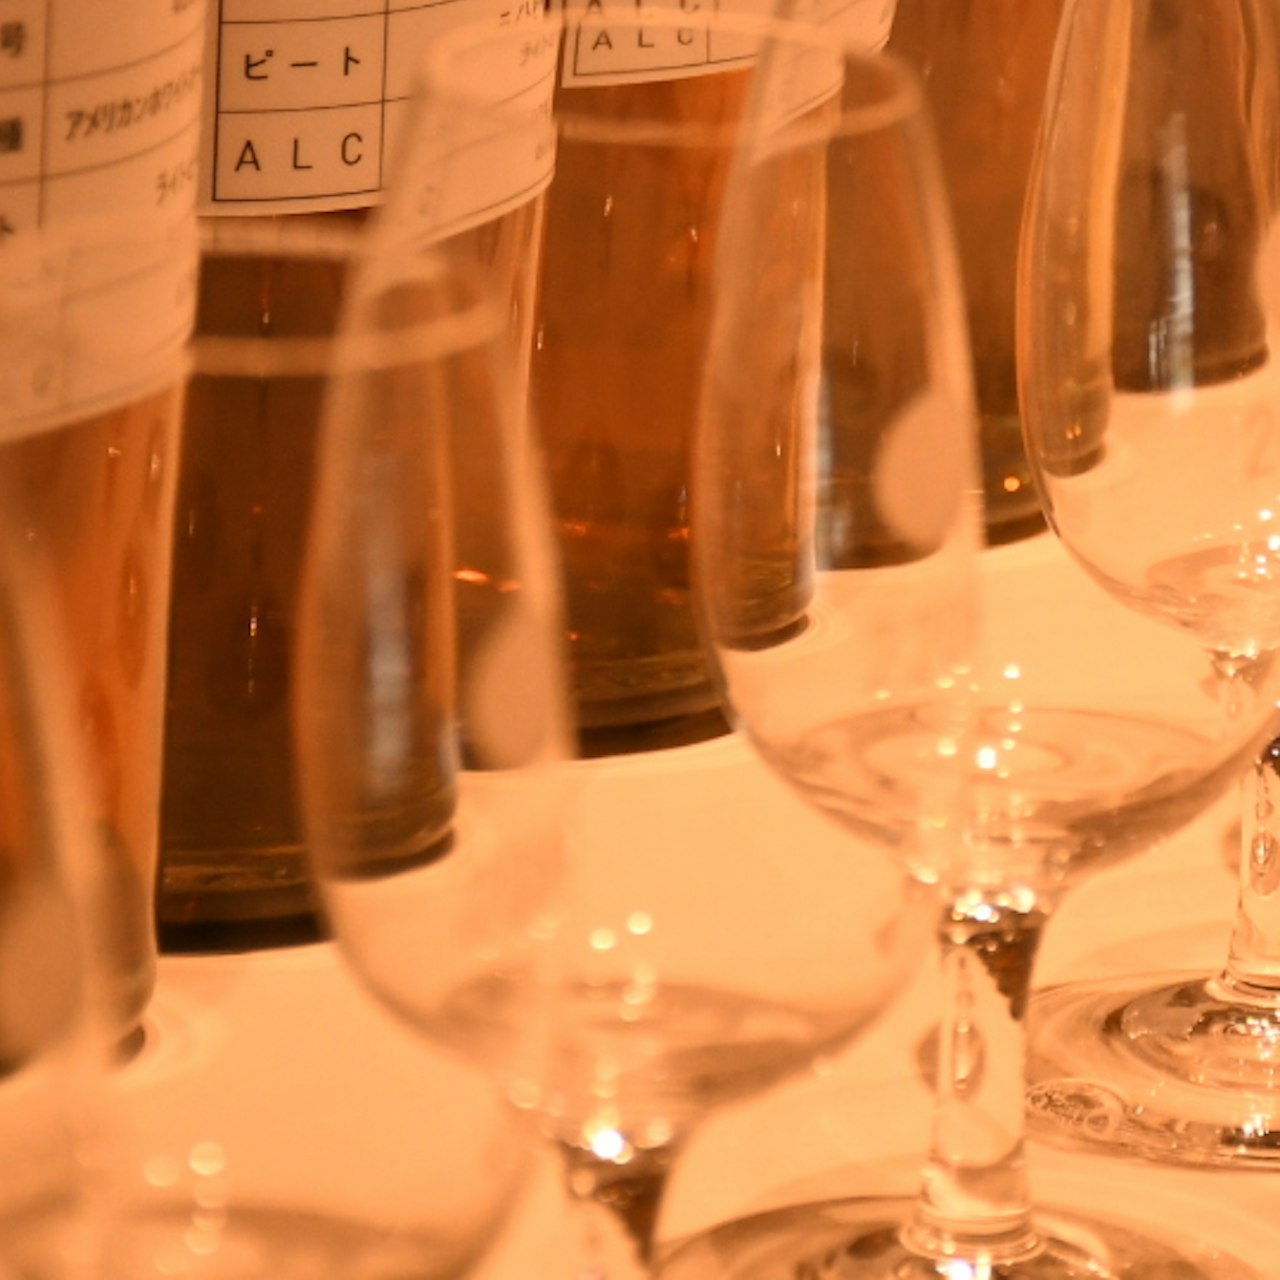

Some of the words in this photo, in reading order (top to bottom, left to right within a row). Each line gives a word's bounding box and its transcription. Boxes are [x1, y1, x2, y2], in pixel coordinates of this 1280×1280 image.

[244, 45, 362, 81] ピート
[235, 132, 365, 173] ALC
